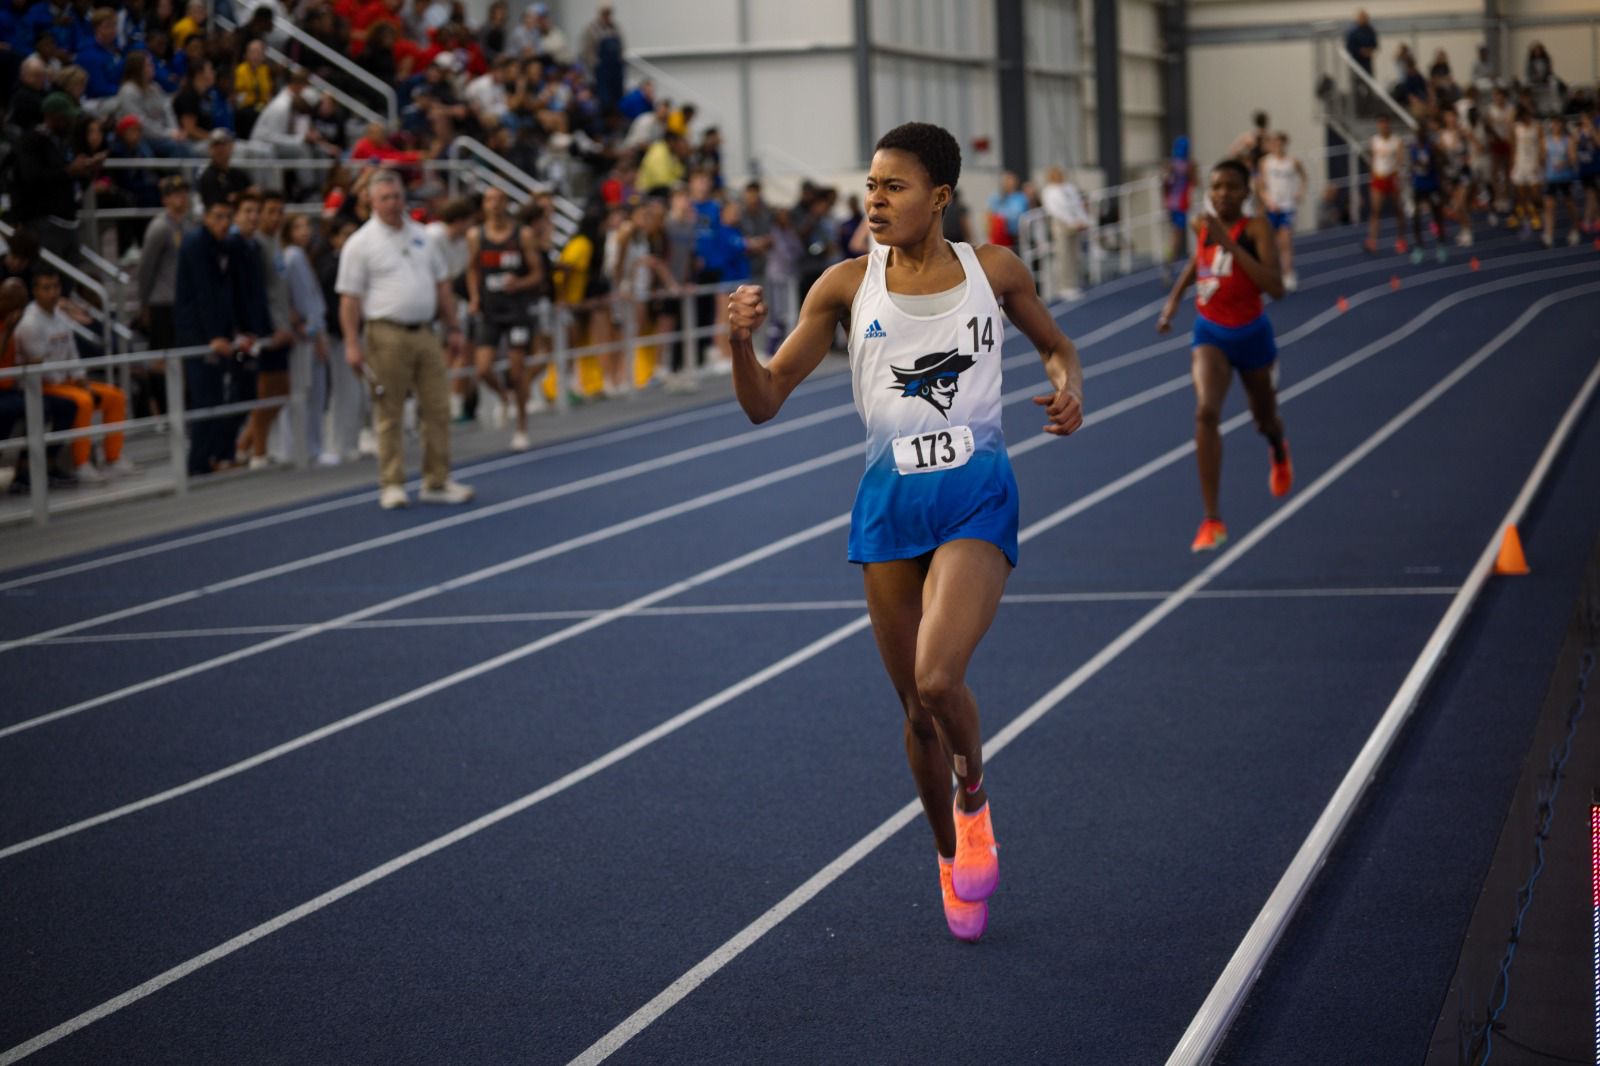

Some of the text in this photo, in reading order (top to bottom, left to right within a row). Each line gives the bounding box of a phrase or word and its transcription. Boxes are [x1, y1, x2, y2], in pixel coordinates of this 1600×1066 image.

[863, 330, 887, 339] adidas
[966, 316, 995, 353] 14
[911, 431, 956, 469] 173
